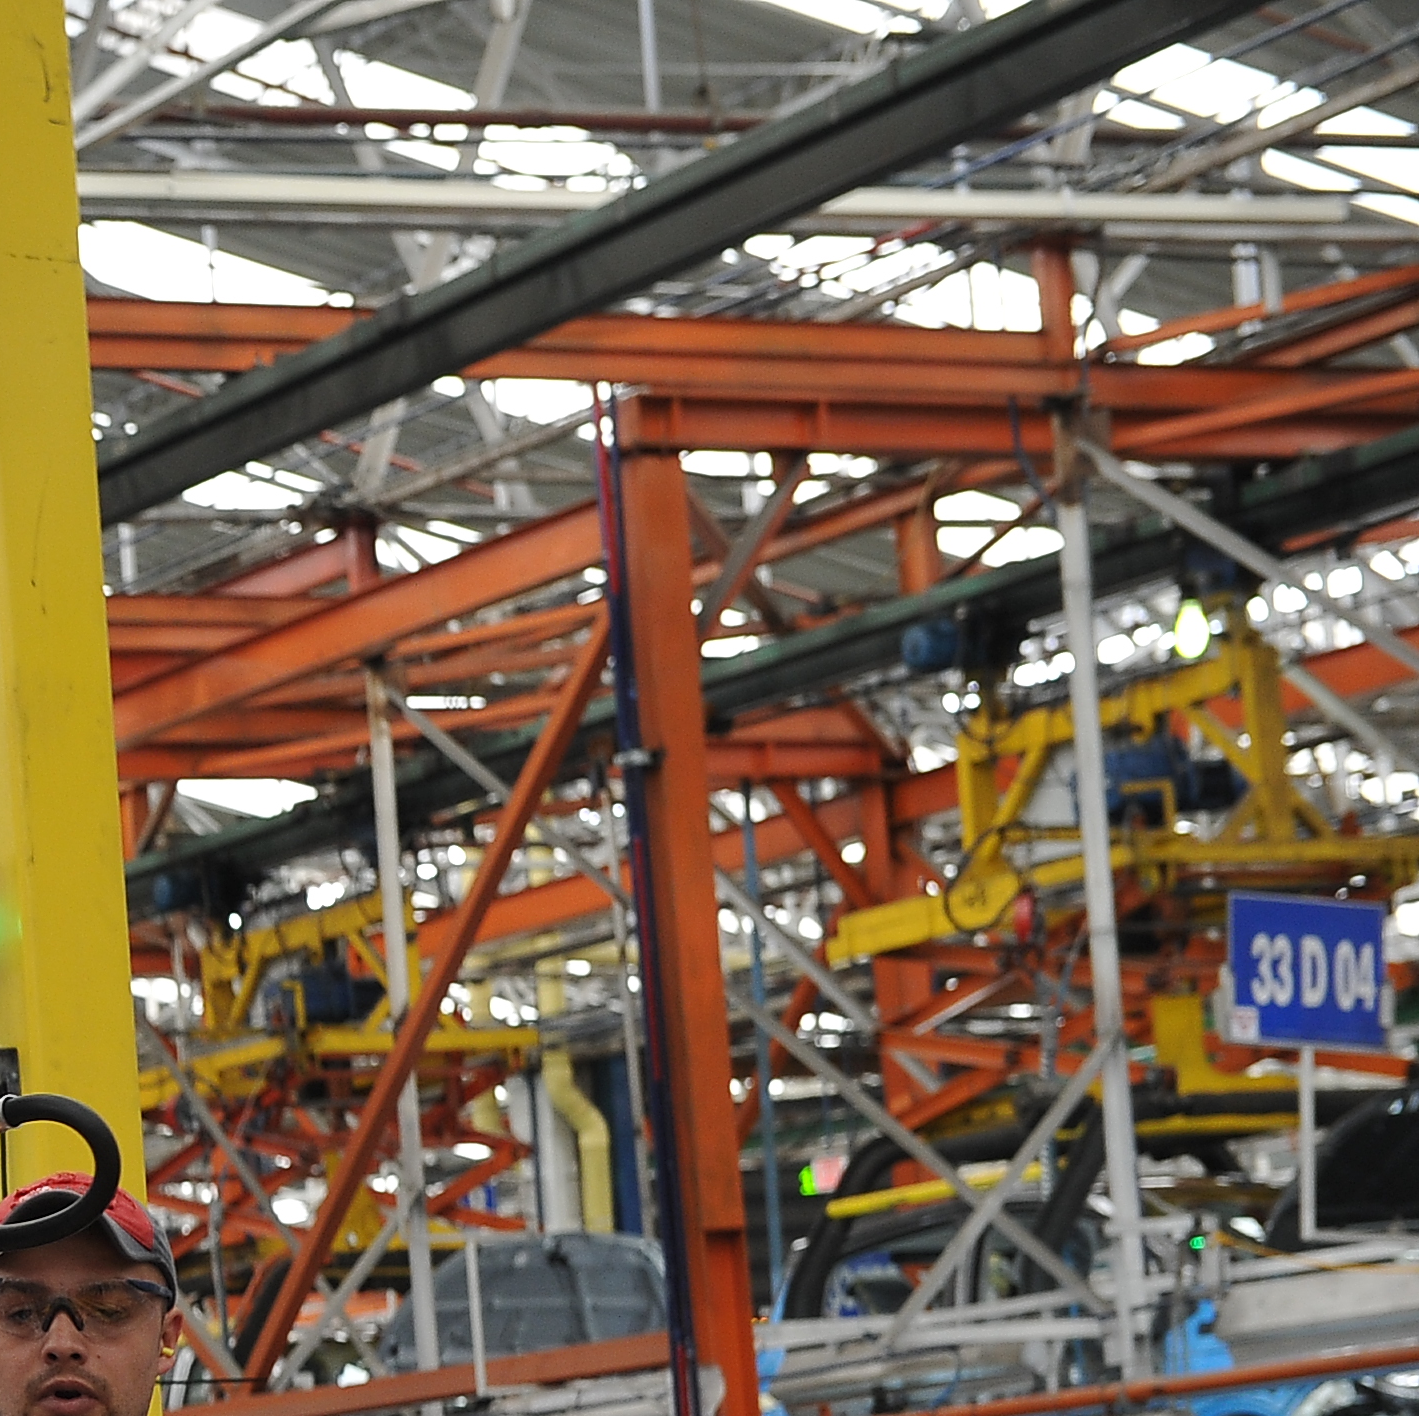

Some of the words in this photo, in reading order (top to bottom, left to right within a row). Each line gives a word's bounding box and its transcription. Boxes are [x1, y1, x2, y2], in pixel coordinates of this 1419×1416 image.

[1250, 931, 1295, 1008] 33
[1299, 934, 1329, 1009] D
[1334, 938, 1377, 1012] 04
